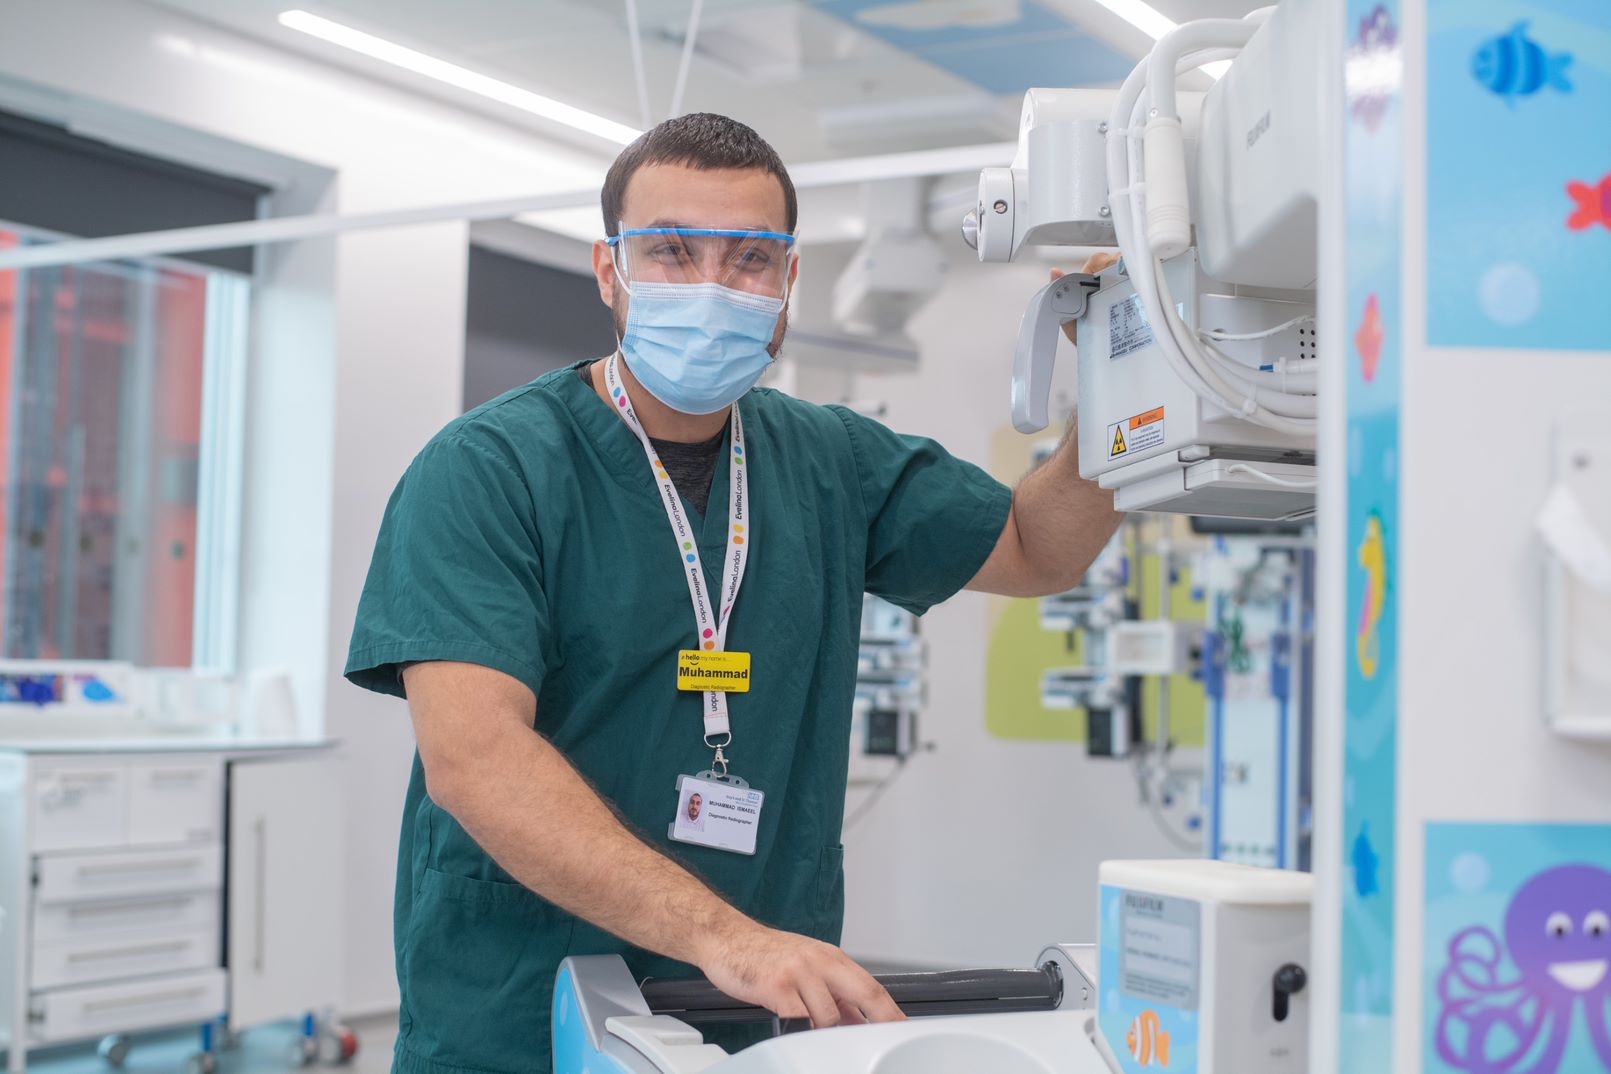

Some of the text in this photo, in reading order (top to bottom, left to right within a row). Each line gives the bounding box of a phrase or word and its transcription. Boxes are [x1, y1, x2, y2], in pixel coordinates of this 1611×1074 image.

[664, 484, 685, 537] EvelinaLondon
[691, 568, 707, 623] EvelinaLondon
[679, 666, 748, 679] Muhammad
[709, 800, 736, 810] MUHAMMAD
